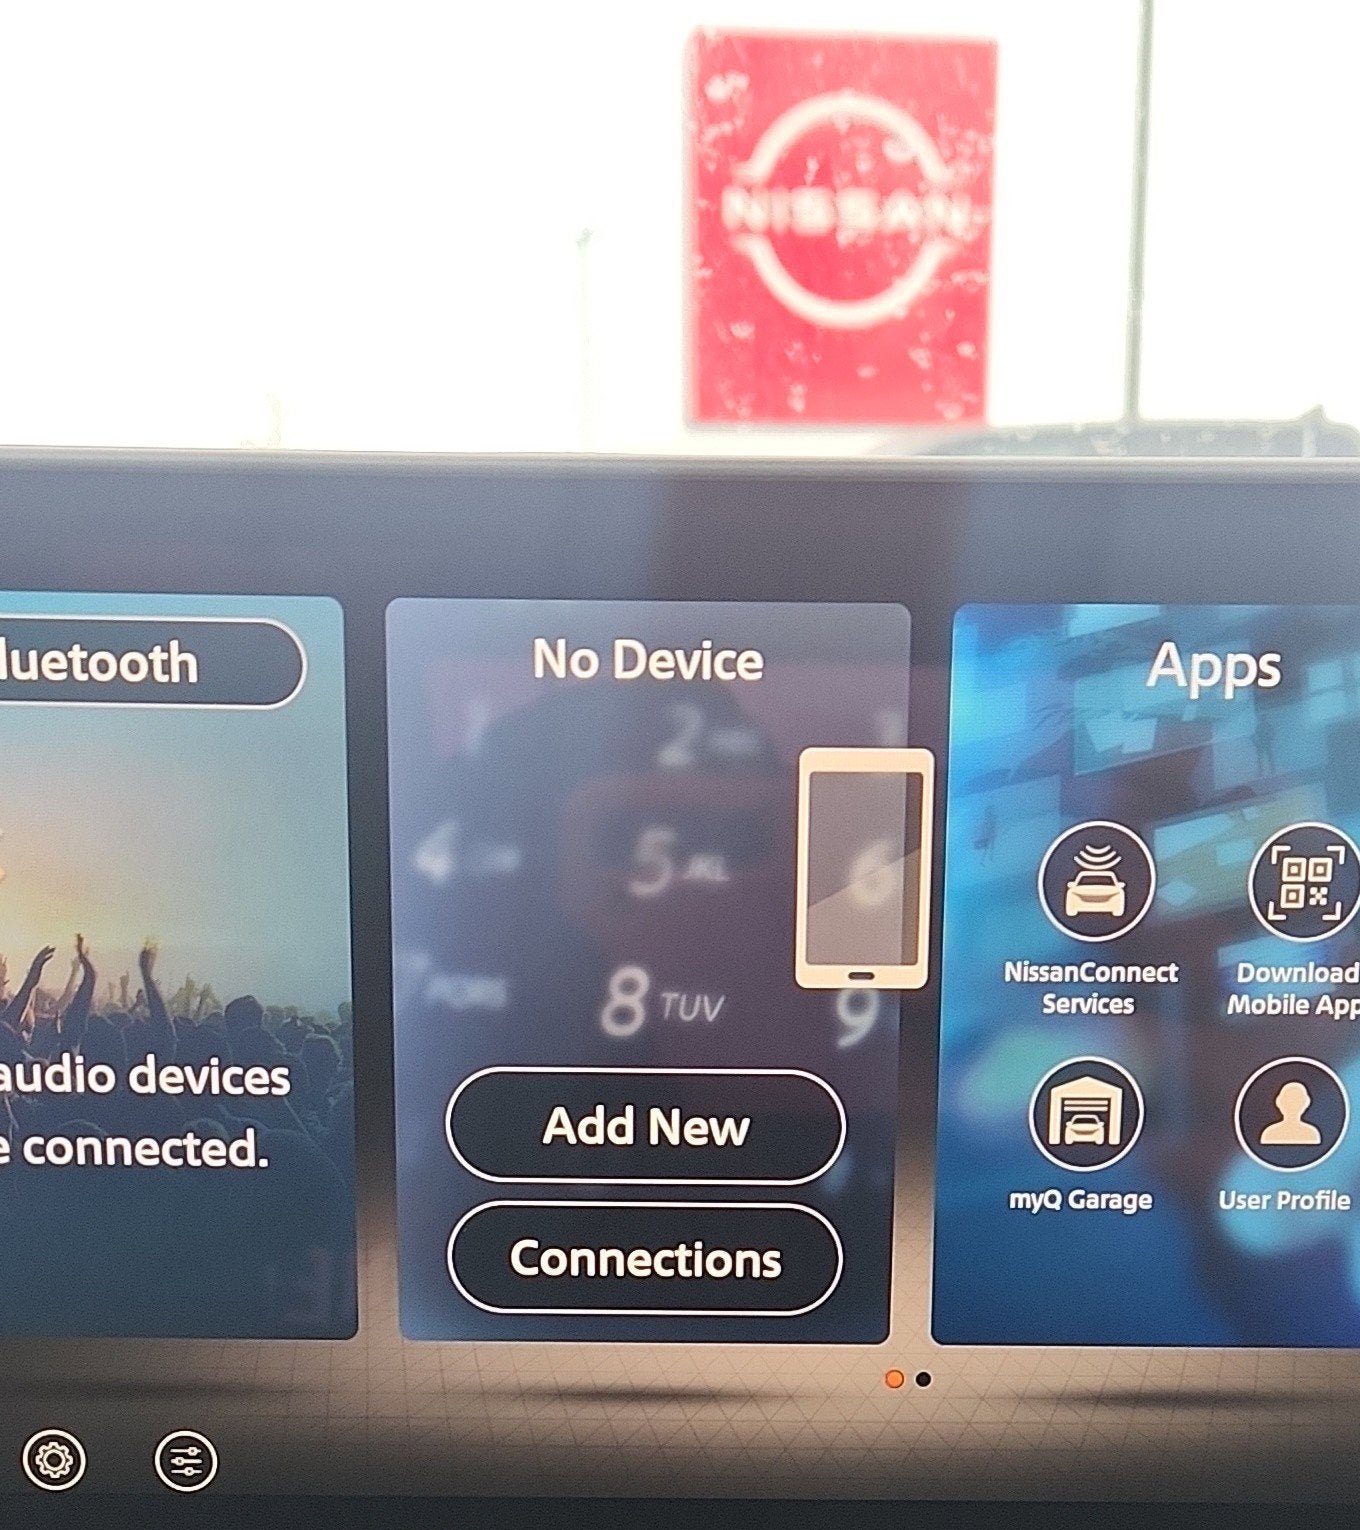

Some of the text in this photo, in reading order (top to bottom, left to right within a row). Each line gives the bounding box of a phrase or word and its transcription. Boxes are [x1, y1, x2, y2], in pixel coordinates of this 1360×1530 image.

[721, 184, 974, 236] NISSAN
[534, 638, 764, 681] No Device
[1145, 641, 1281, 700] Apps
[1004, 960, 1179, 983] NissanConnect
[1237, 961, 1360, 983] Download
[600, 964, 726, 1038] 8 TUV
[1042, 992, 1135, 1015] Services
[1227, 992, 1310, 1015] Mobile
[129, 1053, 291, 1096] devices
[542, 1104, 751, 1146] Add New
[23, 1127, 269, 1168] connected.
[1009, 1189, 1153, 1215] myQ Garage
[1219, 1189, 1351, 1211] User Profile
[510, 1239, 782, 1278] Connections
